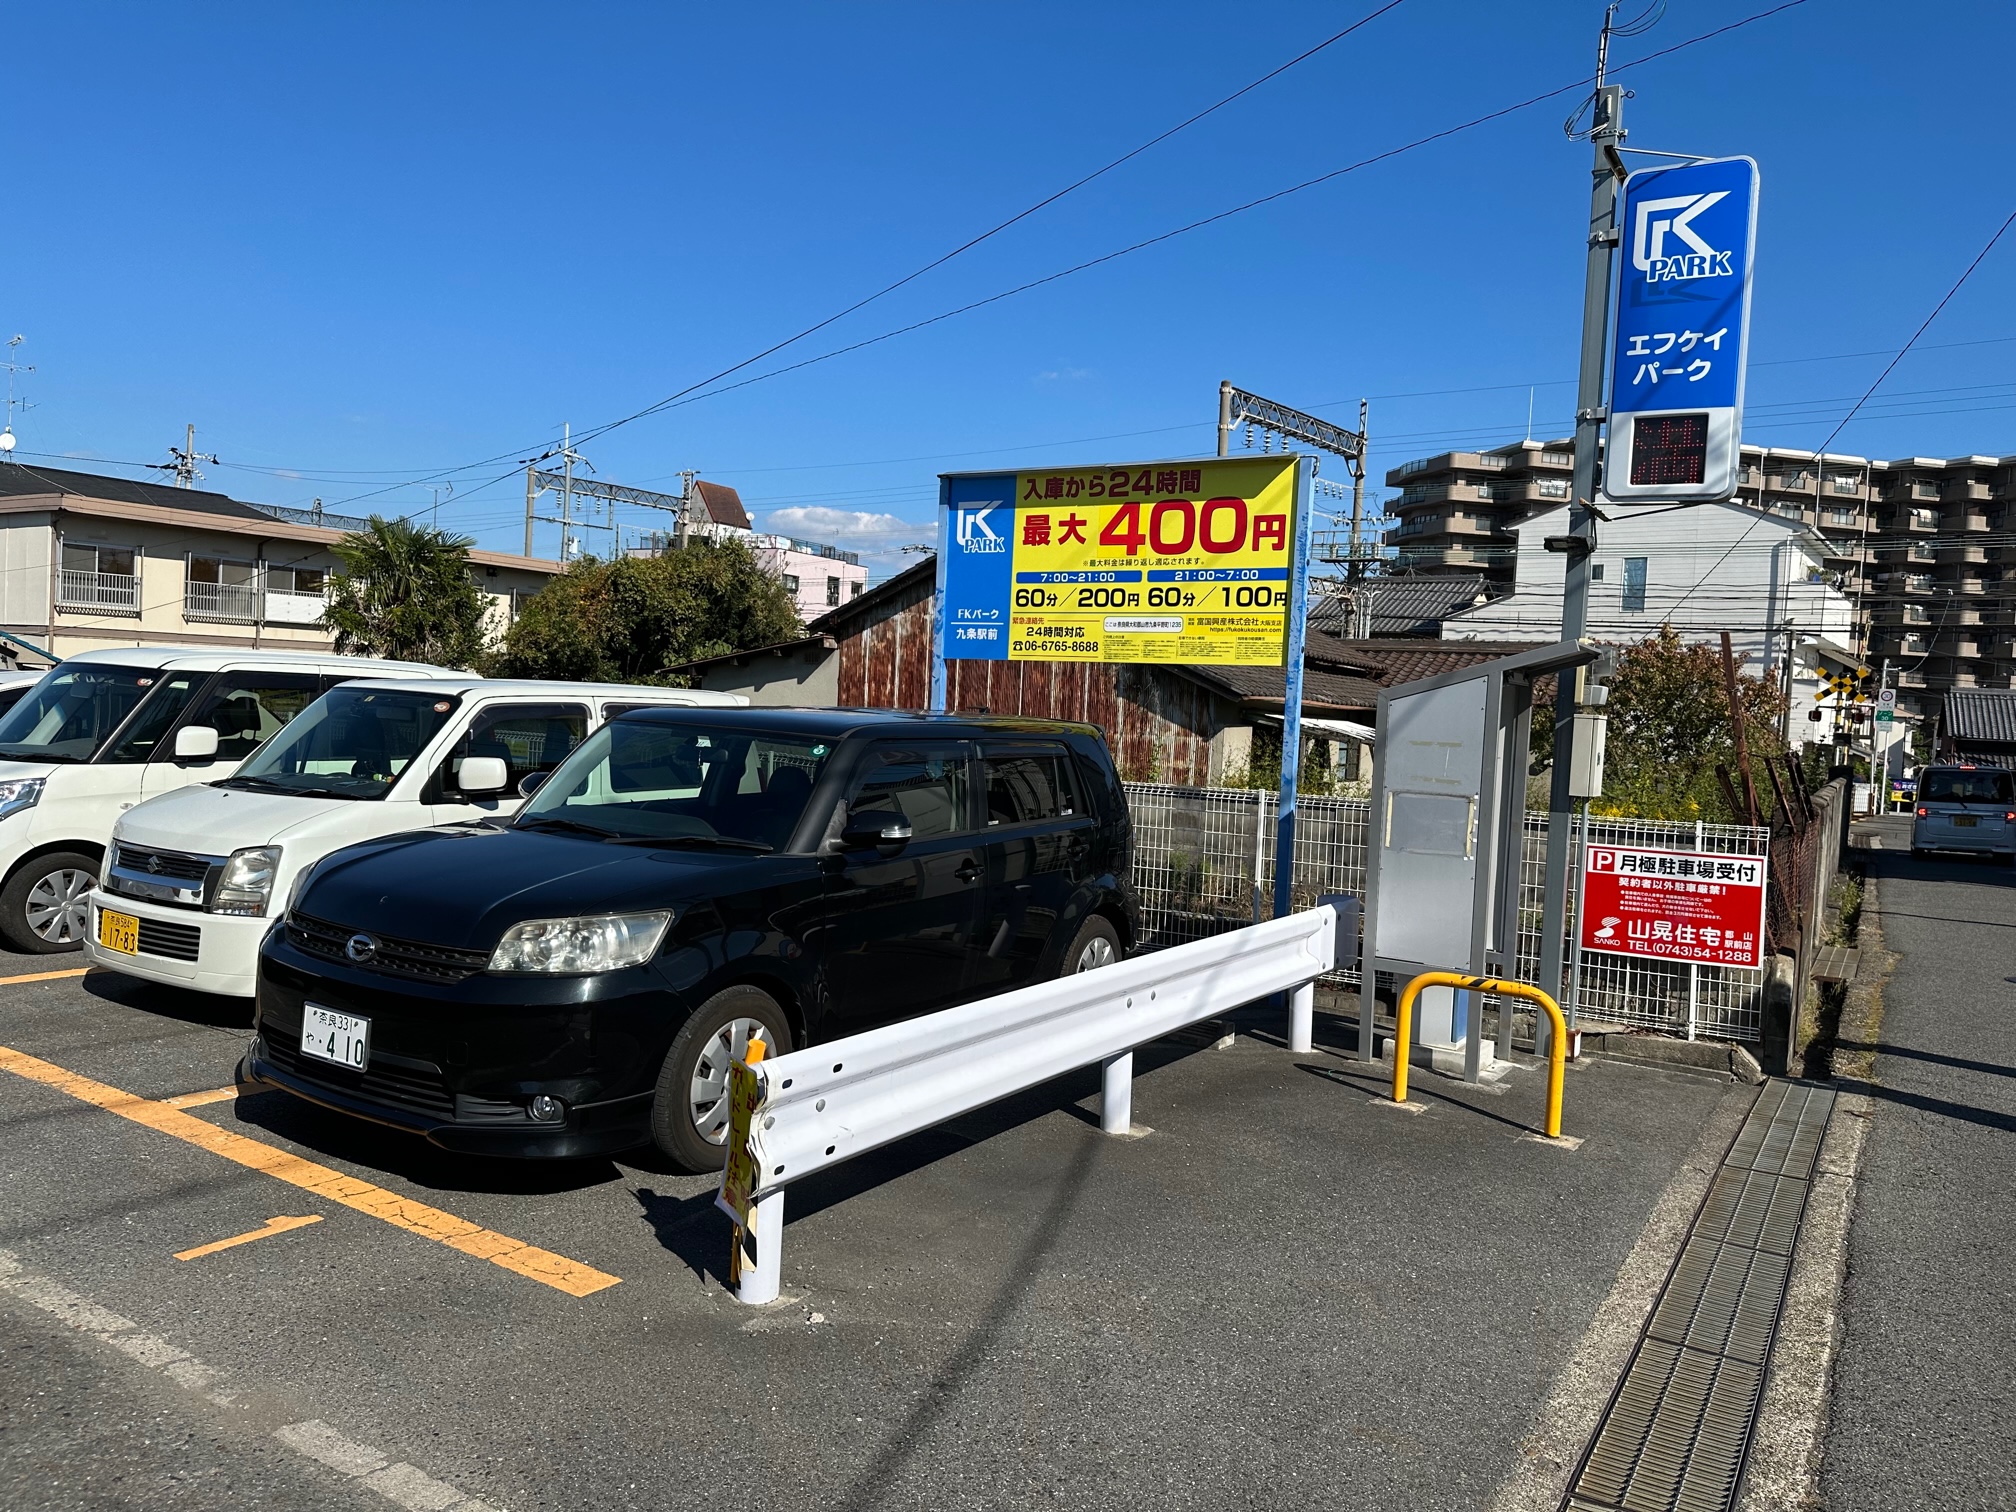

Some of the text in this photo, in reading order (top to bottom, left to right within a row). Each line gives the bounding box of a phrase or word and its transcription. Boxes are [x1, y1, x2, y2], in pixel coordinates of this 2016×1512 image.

[1646, 251, 1733, 283] PARK
[1626, 327, 1728, 356] エフケイ
[1632, 358, 1711, 385] パーク
[1023, 469, 1202, 501] 入庫から24時間
[963, 537, 1005, 553] PARK
[957, 609, 999, 620] FKパーク
[1012, 617, 1045, 625] 緊急連絡先
[1196, 617, 1259, 626] 富国興産株式会社
[956, 628, 998, 640] 九条駅前
[1026, 626, 1085, 638] 24時間対応
[1024, 640, 1099, 652] 06-6765-8688
[1596, 852, 1756, 882] P 月極駐車場受付
[1627, 919, 1721, 947] 山晃住宅
[1593, 937, 1621, 947] SANKO
[1724, 939, 1753, 951] 駅前店
[318, 1011, 353, 1033] 奈良331
[723, 1066, 744, 1210] ガードレール注意
